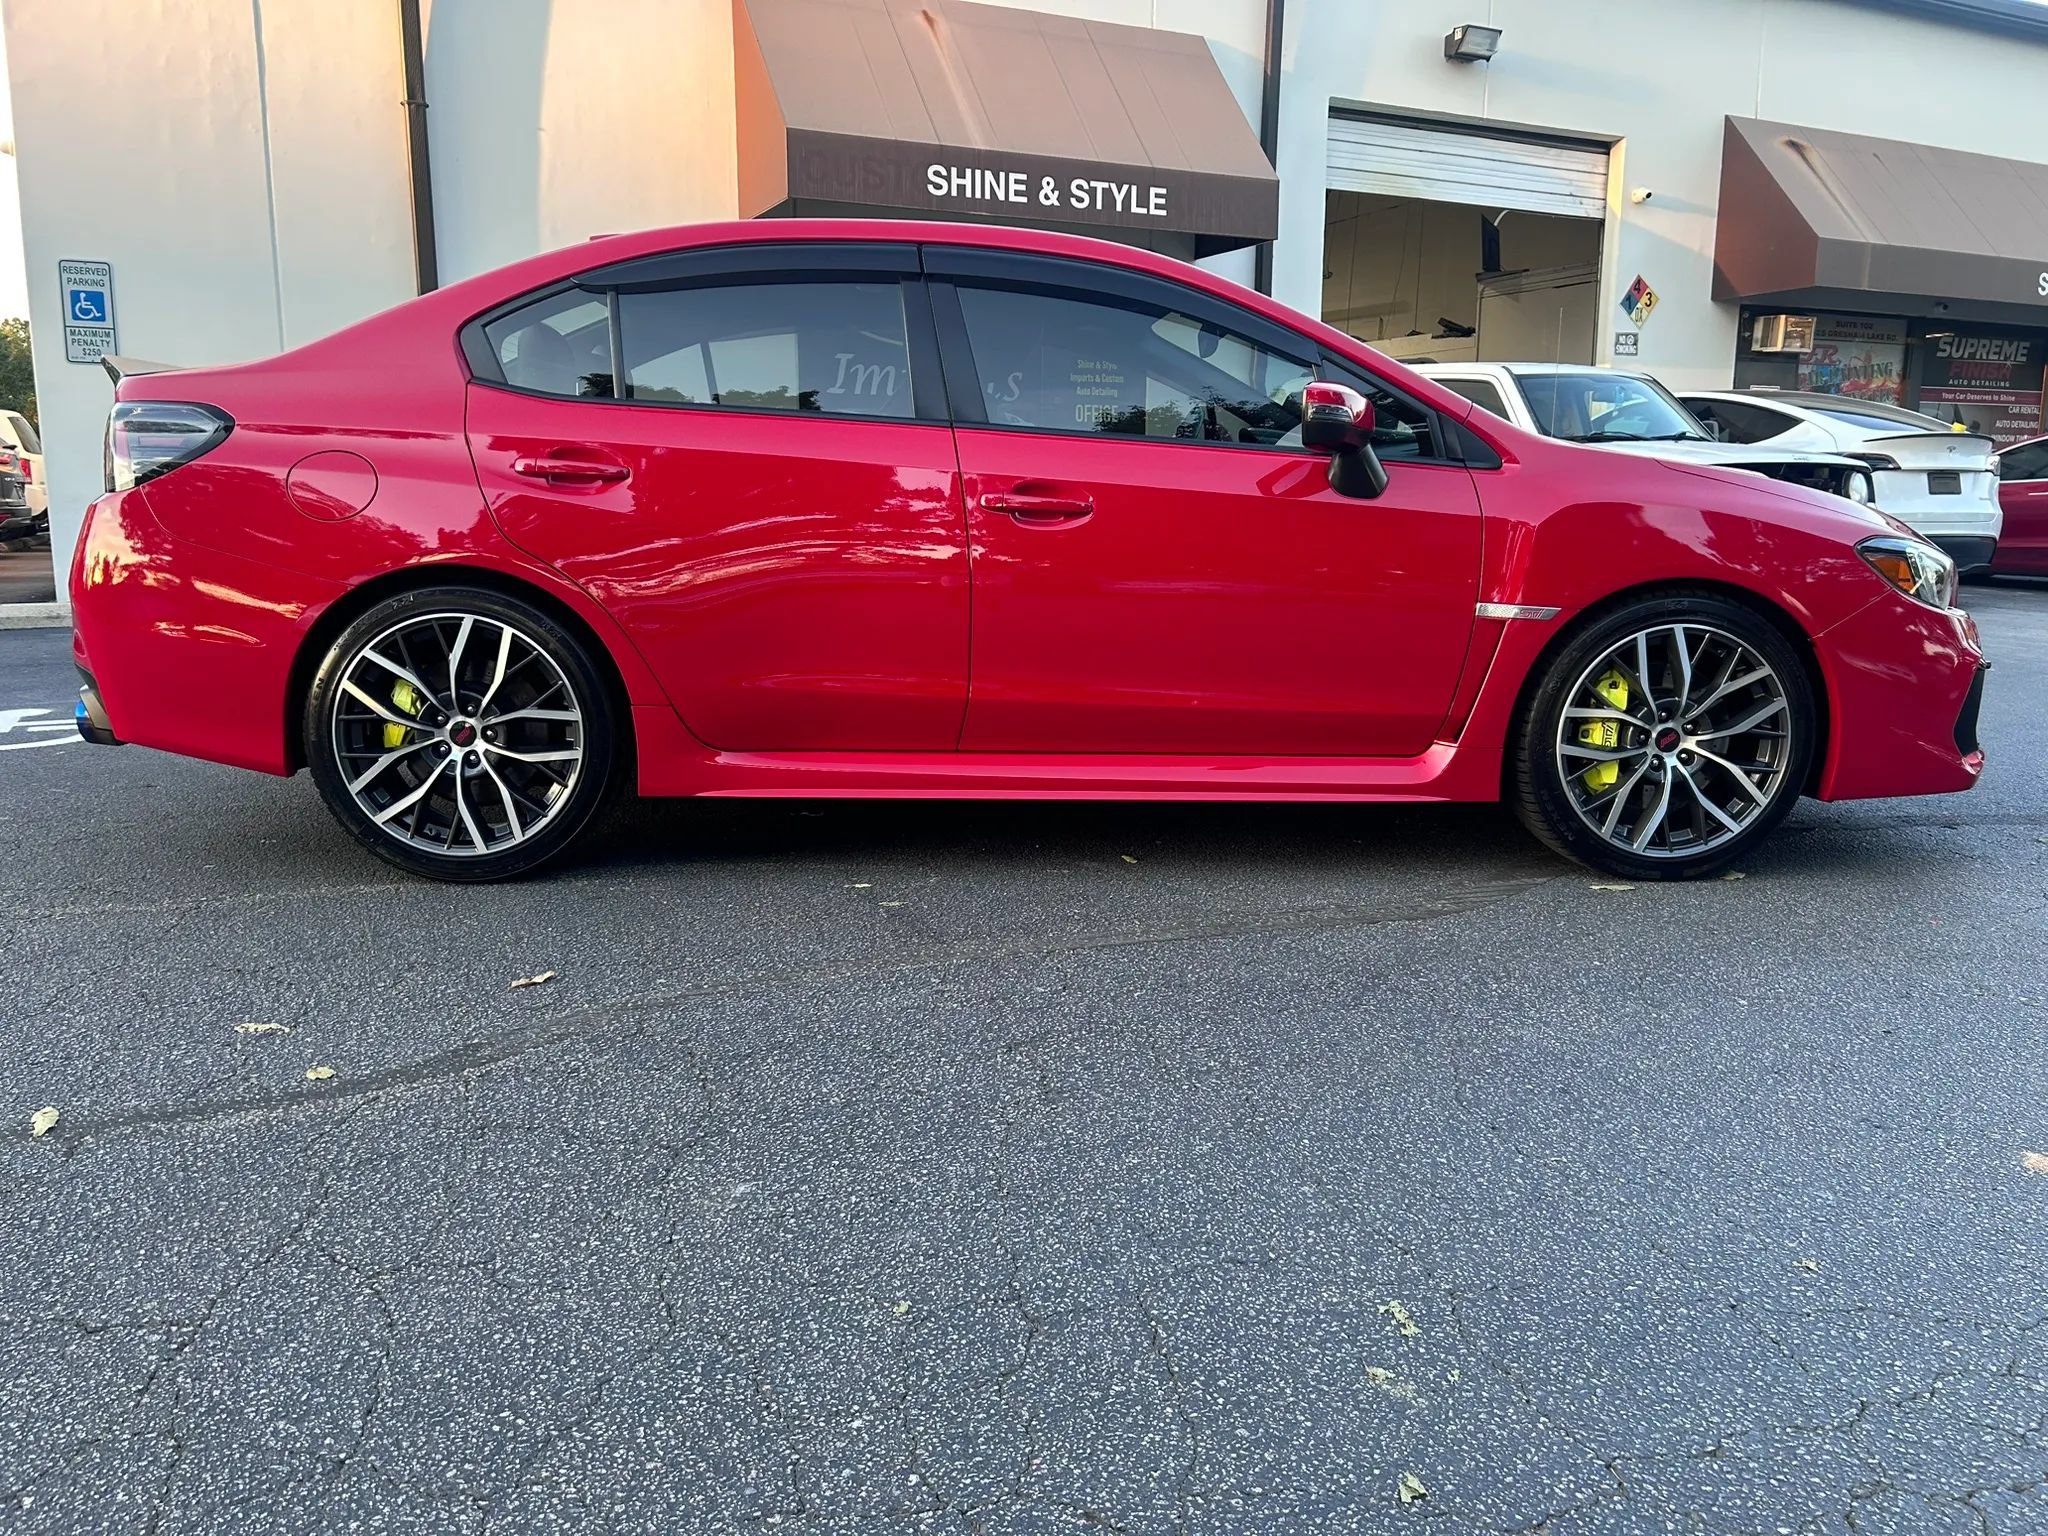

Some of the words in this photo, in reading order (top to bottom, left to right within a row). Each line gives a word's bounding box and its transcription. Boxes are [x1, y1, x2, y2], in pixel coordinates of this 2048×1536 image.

[927, 164, 1028, 203] SHINE
[1038, 176, 1060, 207] &
[1070, 179, 1168, 216] STYLE
[62, 266, 108, 276] RESERVED
[66, 277, 105, 287] PARKING
[1633, 279, 1641, 294] 4
[1626, 295, 1632, 310] 1
[1645, 291, 1653, 307] 3
[69, 328, 111, 338] MAXIMUM
[71, 338, 111, 348] PENALTY
[82, 348, 102, 356] $250
[1936, 336, 2031, 361] SUPREME
[1948, 361, 2012, 378] FINISH
[1942, 392, 1955, 400] Your
[1966, 393, 1992, 401] Deserves
[2000, 394, 2016, 402] Shine
[1075, 404, 1119, 423] OFFICE
[2008, 406, 2019, 414] CAR
[2020, 406, 2040, 414] RENTAL
[1995, 420, 2011, 428] AUTO
